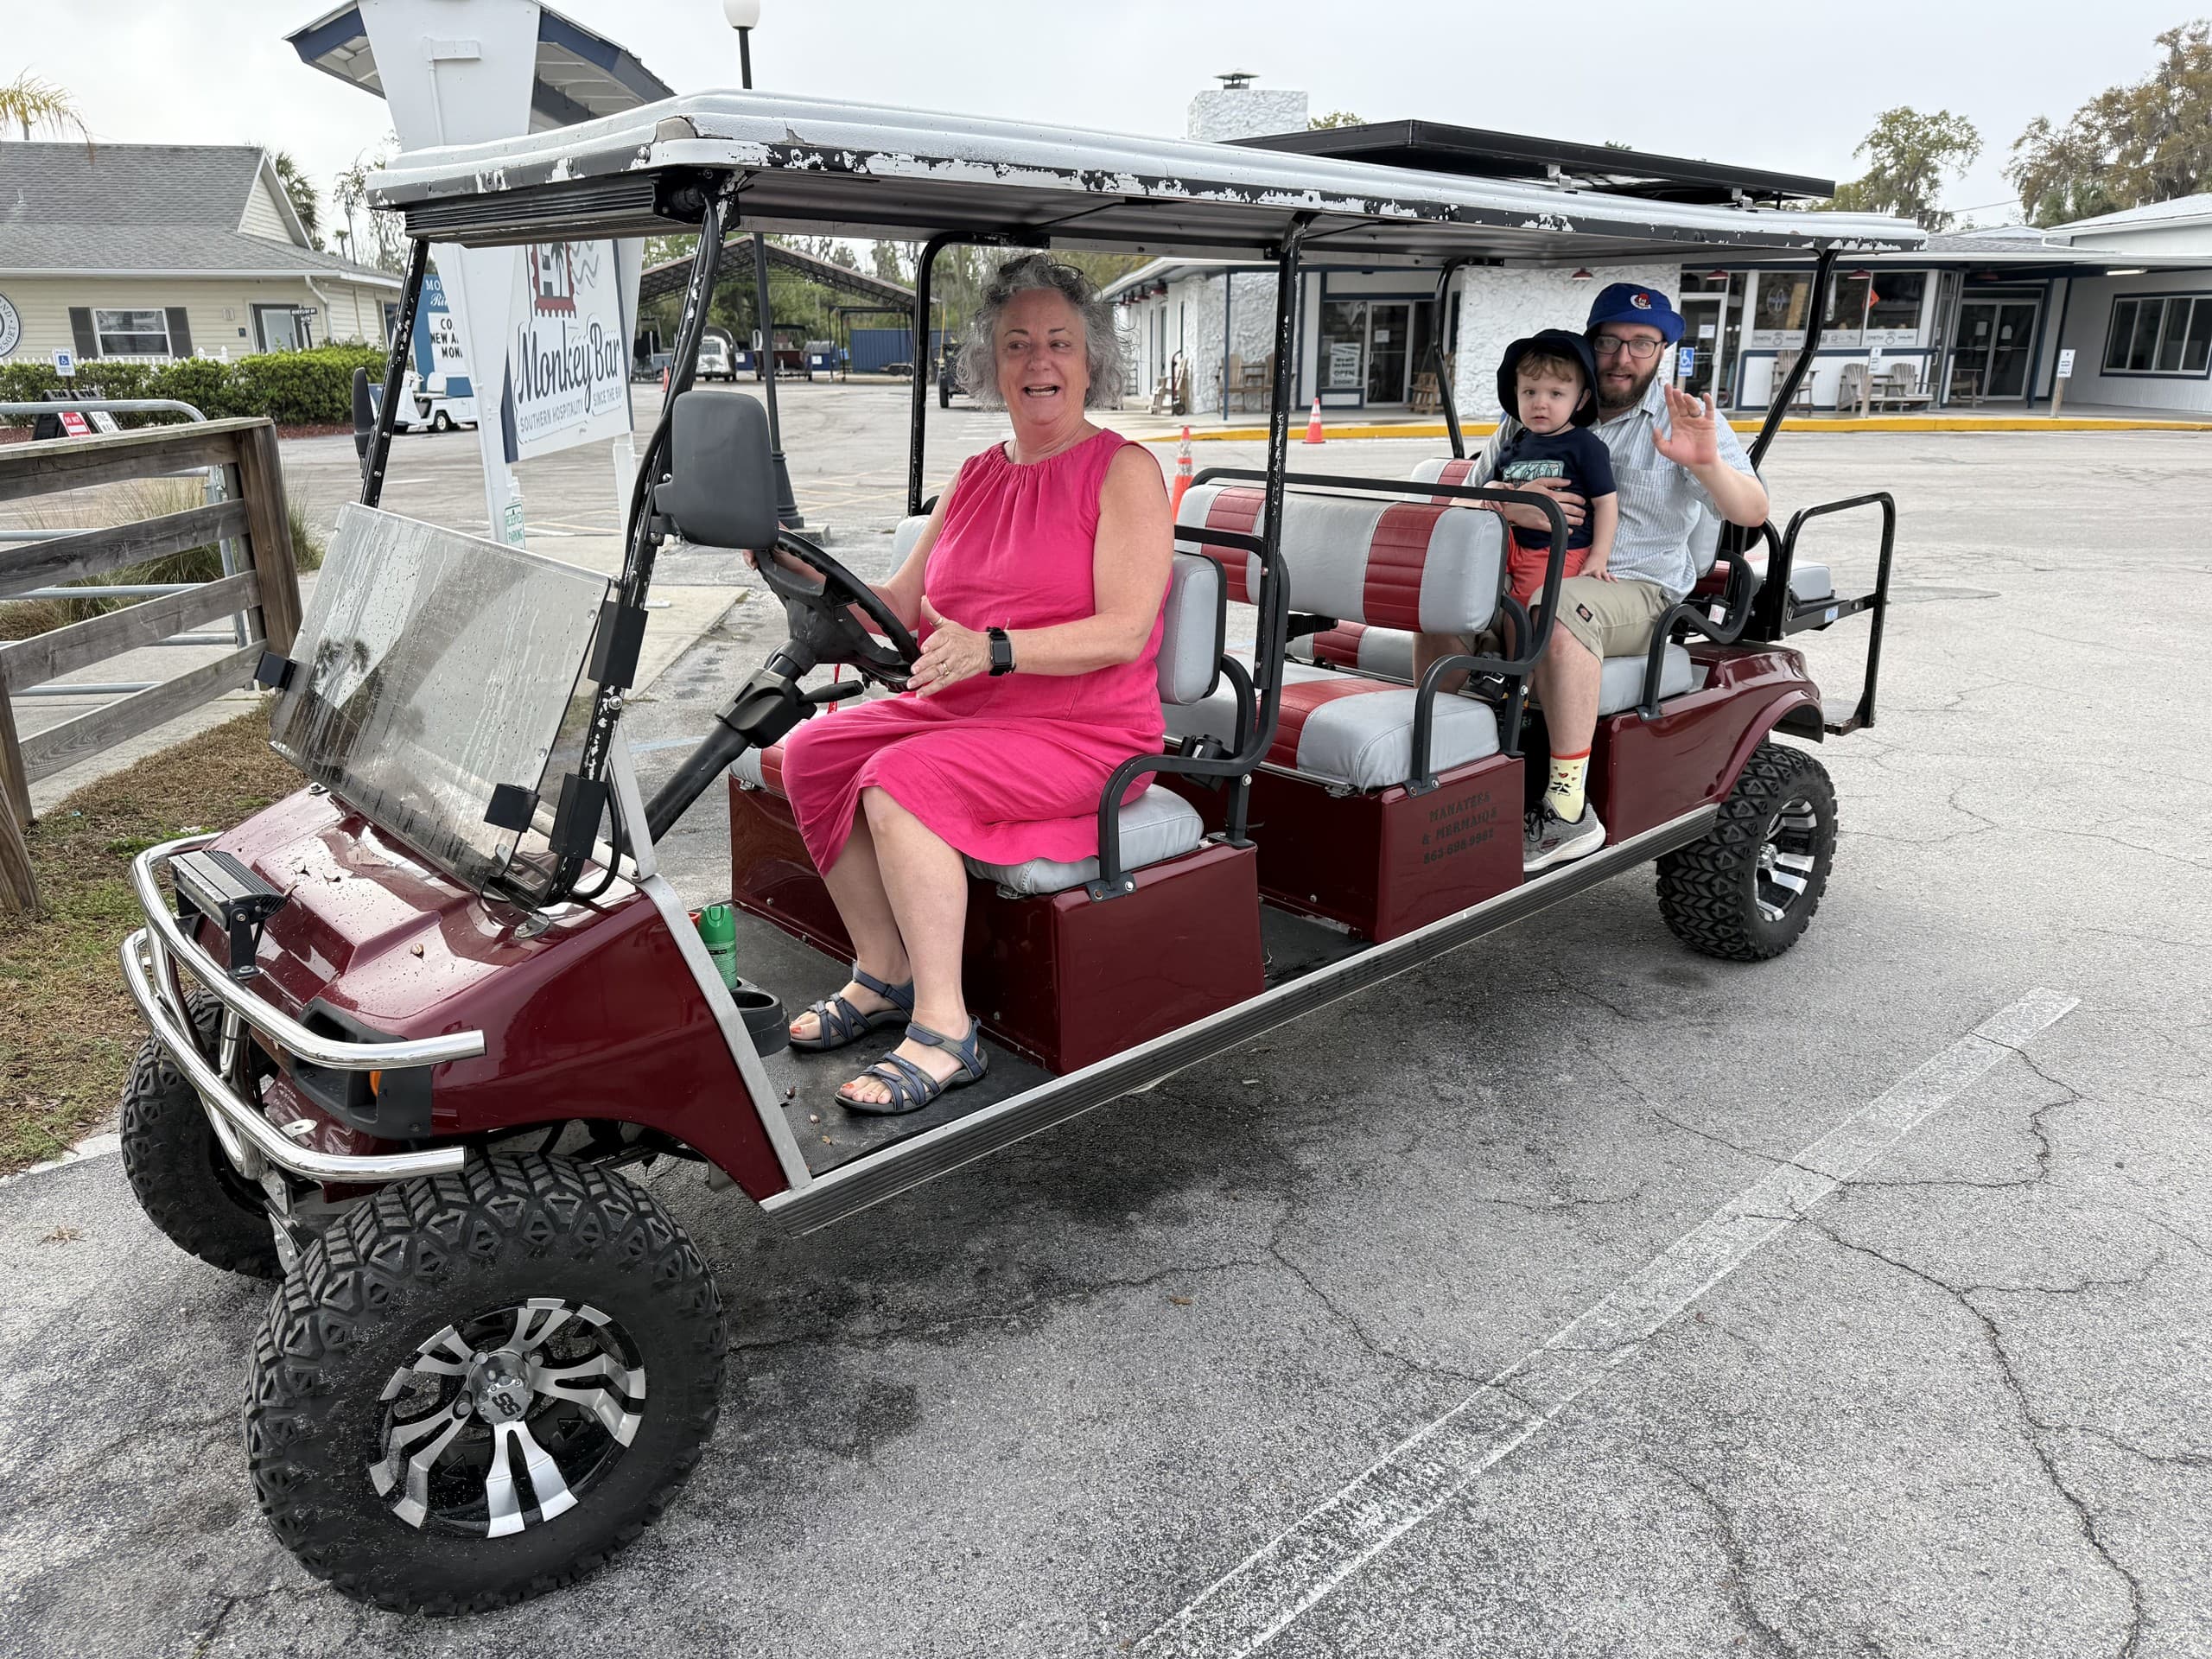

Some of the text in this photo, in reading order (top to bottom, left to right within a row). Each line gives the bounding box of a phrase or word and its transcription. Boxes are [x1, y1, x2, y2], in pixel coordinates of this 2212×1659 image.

[425, 278, 442, 291] MO
[441, 318, 454, 330] CO
[429, 333, 459, 345] NEW A
[442, 346, 463, 359] MON
[518, 320, 620, 414] Monkey Bar
[519, 407, 551, 432] SOUTHERN
[552, 398, 584, 423] HOSPITALITY
[593, 389, 607, 407] SINCE
[1435, 806, 1497, 841] MERMAIDS
